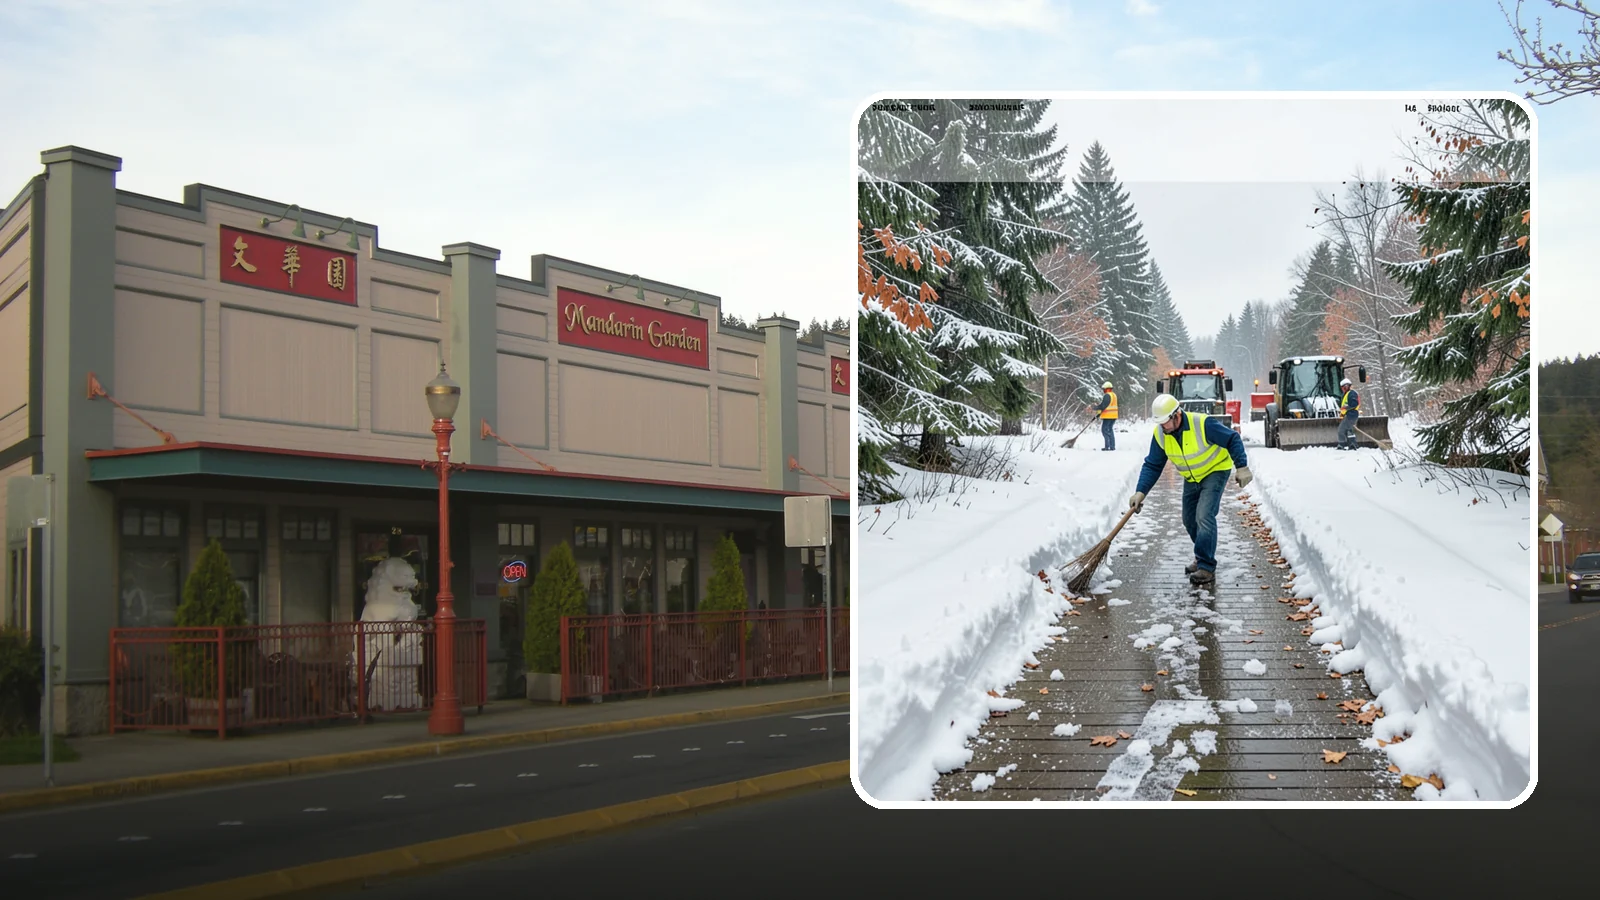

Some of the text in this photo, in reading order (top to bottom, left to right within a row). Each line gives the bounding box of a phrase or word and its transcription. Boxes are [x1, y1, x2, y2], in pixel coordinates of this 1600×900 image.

[231, 236, 346, 291] 文華園
[565, 302, 701, 352] Mandarin Garden
[503, 565, 527, 578] OPEN
